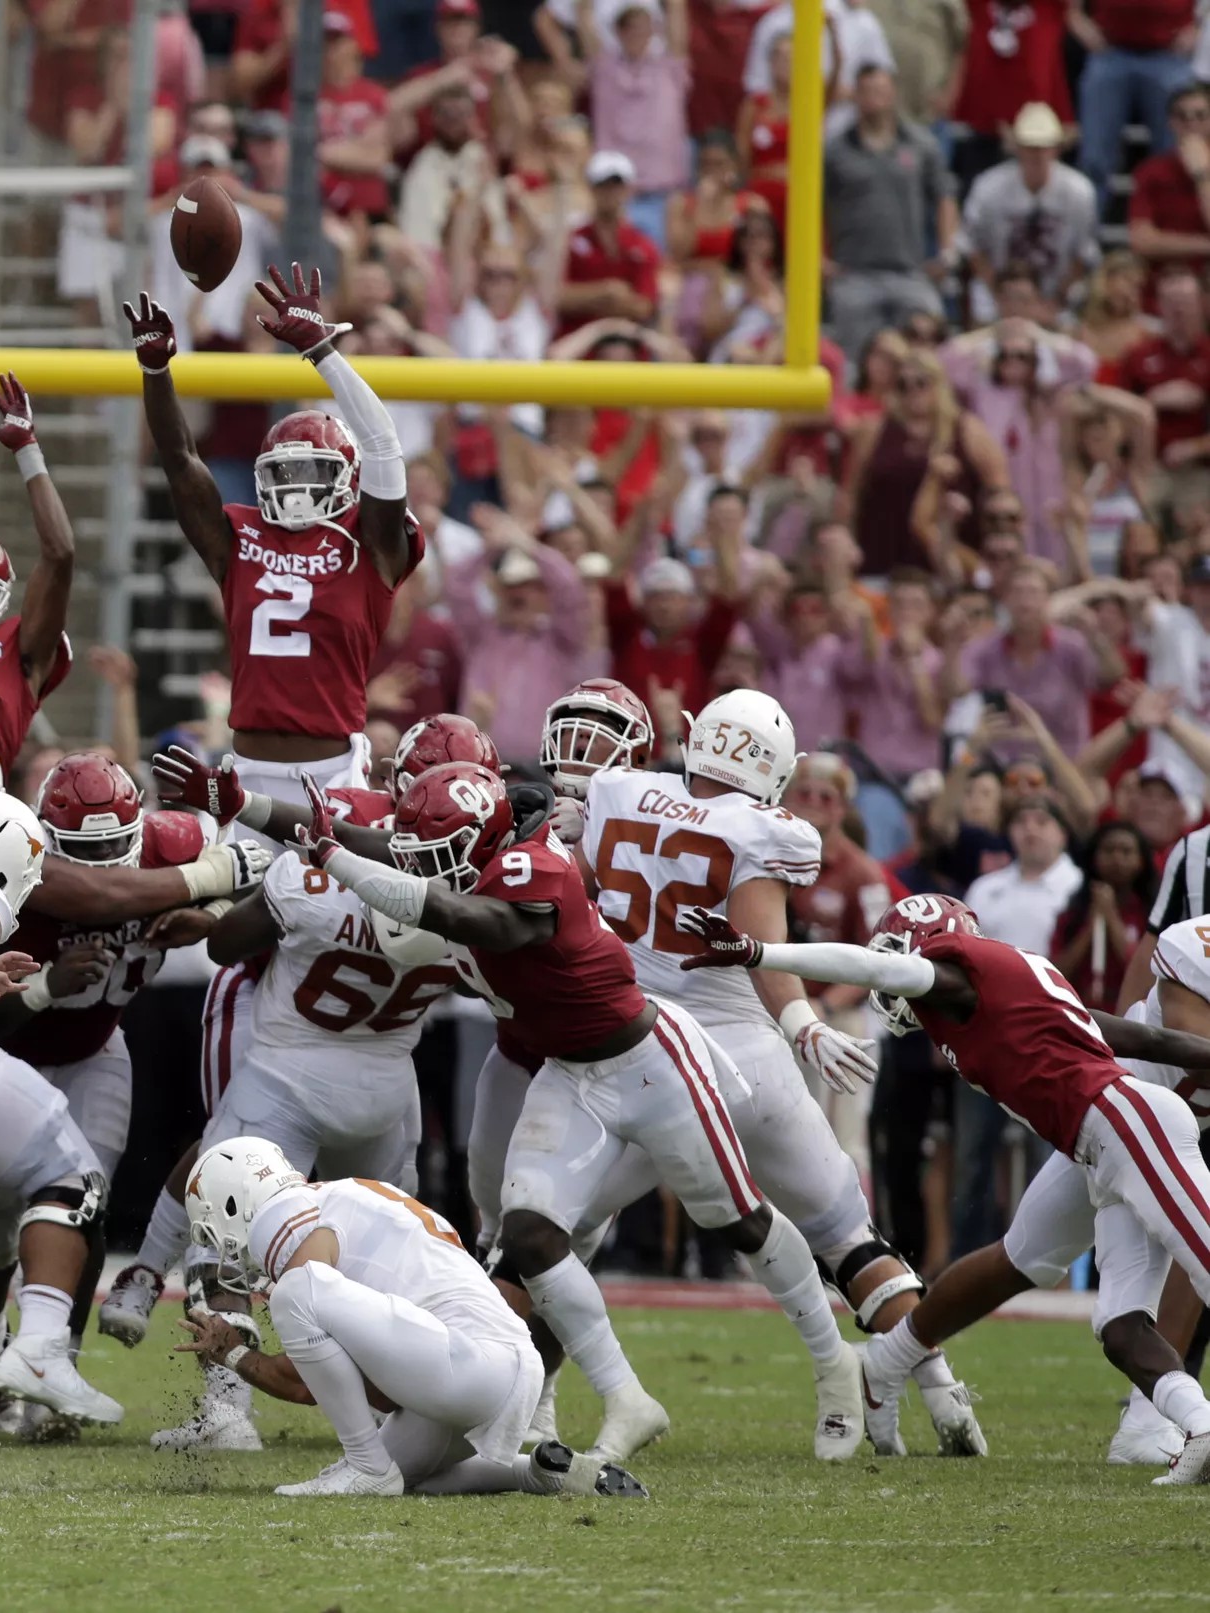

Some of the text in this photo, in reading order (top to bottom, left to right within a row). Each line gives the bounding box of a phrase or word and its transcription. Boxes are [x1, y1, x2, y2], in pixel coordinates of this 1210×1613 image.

[238, 538, 342, 576] SOONERS
[249, 571, 314, 656] 2
[712, 722, 753, 763] 52
[698, 763, 747, 788] LONGHORNS
[449, 779, 496, 824] OU
[501, 852, 533, 887] 9
[595, 817, 736, 956] 52
[895, 895, 943, 924] OU
